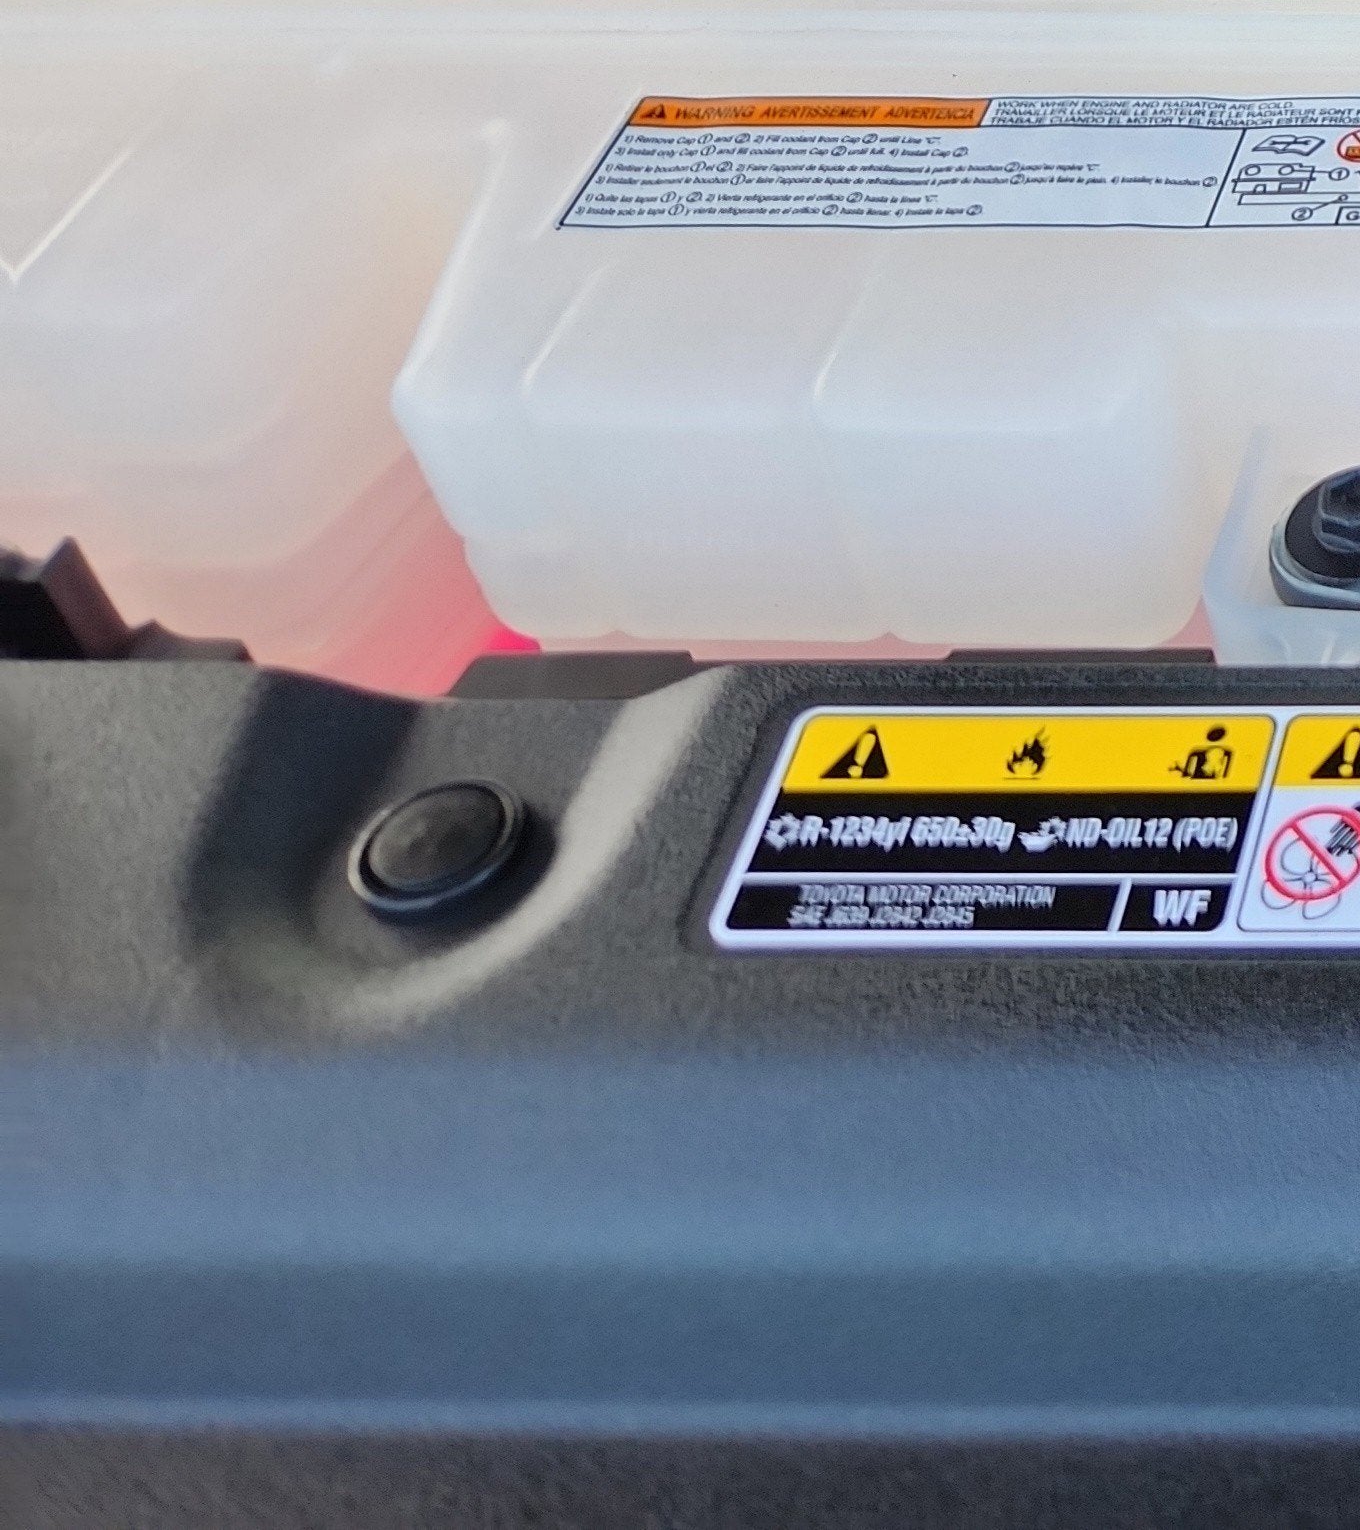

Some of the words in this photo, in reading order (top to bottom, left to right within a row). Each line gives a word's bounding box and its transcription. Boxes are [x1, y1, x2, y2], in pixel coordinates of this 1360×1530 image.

[1162, 101, 1229, 109] RADIATOR
[1230, 102, 1255, 110] ARE
[676, 106, 755, 119] WARNING
[760, 106, 879, 118] AVERTISSEMENT
[886, 107, 974, 119] ADVERTENCIA
[1247, 109, 1315, 117] RADIATEUR
[1207, 118, 1272, 126] RADIADOR
[635, 135, 674, 144] Remove
[677, 137, 695, 145] Cap
[782, 135, 817, 143] coolant
[817, 135, 839, 143] from
[841, 135, 861, 145] Cap
[880, 135, 901, 143] until
[902, 136, 922, 144] Line
[657, 148, 676, 158] only
[679, 149, 698, 158] Cap
[809, 148, 829, 156] Cap
[931, 149, 951, 158] Cap
[654, 164, 690, 173] bouchon
[818, 164, 847, 173] liquide
[847, 164, 858, 172] de
[860, 164, 923, 173] refroidissement
[967, 164, 1003, 172] bouchon
[606, 176, 638, 184] Installer
[640, 177, 683, 185] seulement
[825, 177, 851, 185] liquide
[866, 178, 928, 186] refroidissement
[973, 177, 1010, 185] bouchon
[1165, 178, 1200, 186] bouchon
[620, 194, 633, 202] las
[864, 195, 888, 203] hasta
[617, 207, 635, 216] solo
[647, 208, 666, 216] tapa
[782, 207, 792, 215] el
[840, 207, 864, 215] hasta
[799, 815, 912, 853] R-1234yf
[1172, 817, 1238, 853] (POE)
[798, 885, 865, 904] TOYOTA
[866, 885, 932, 905] MOTOR
[932, 885, 1056, 908] CORPORATION
[1153, 890, 1212, 927] WF
